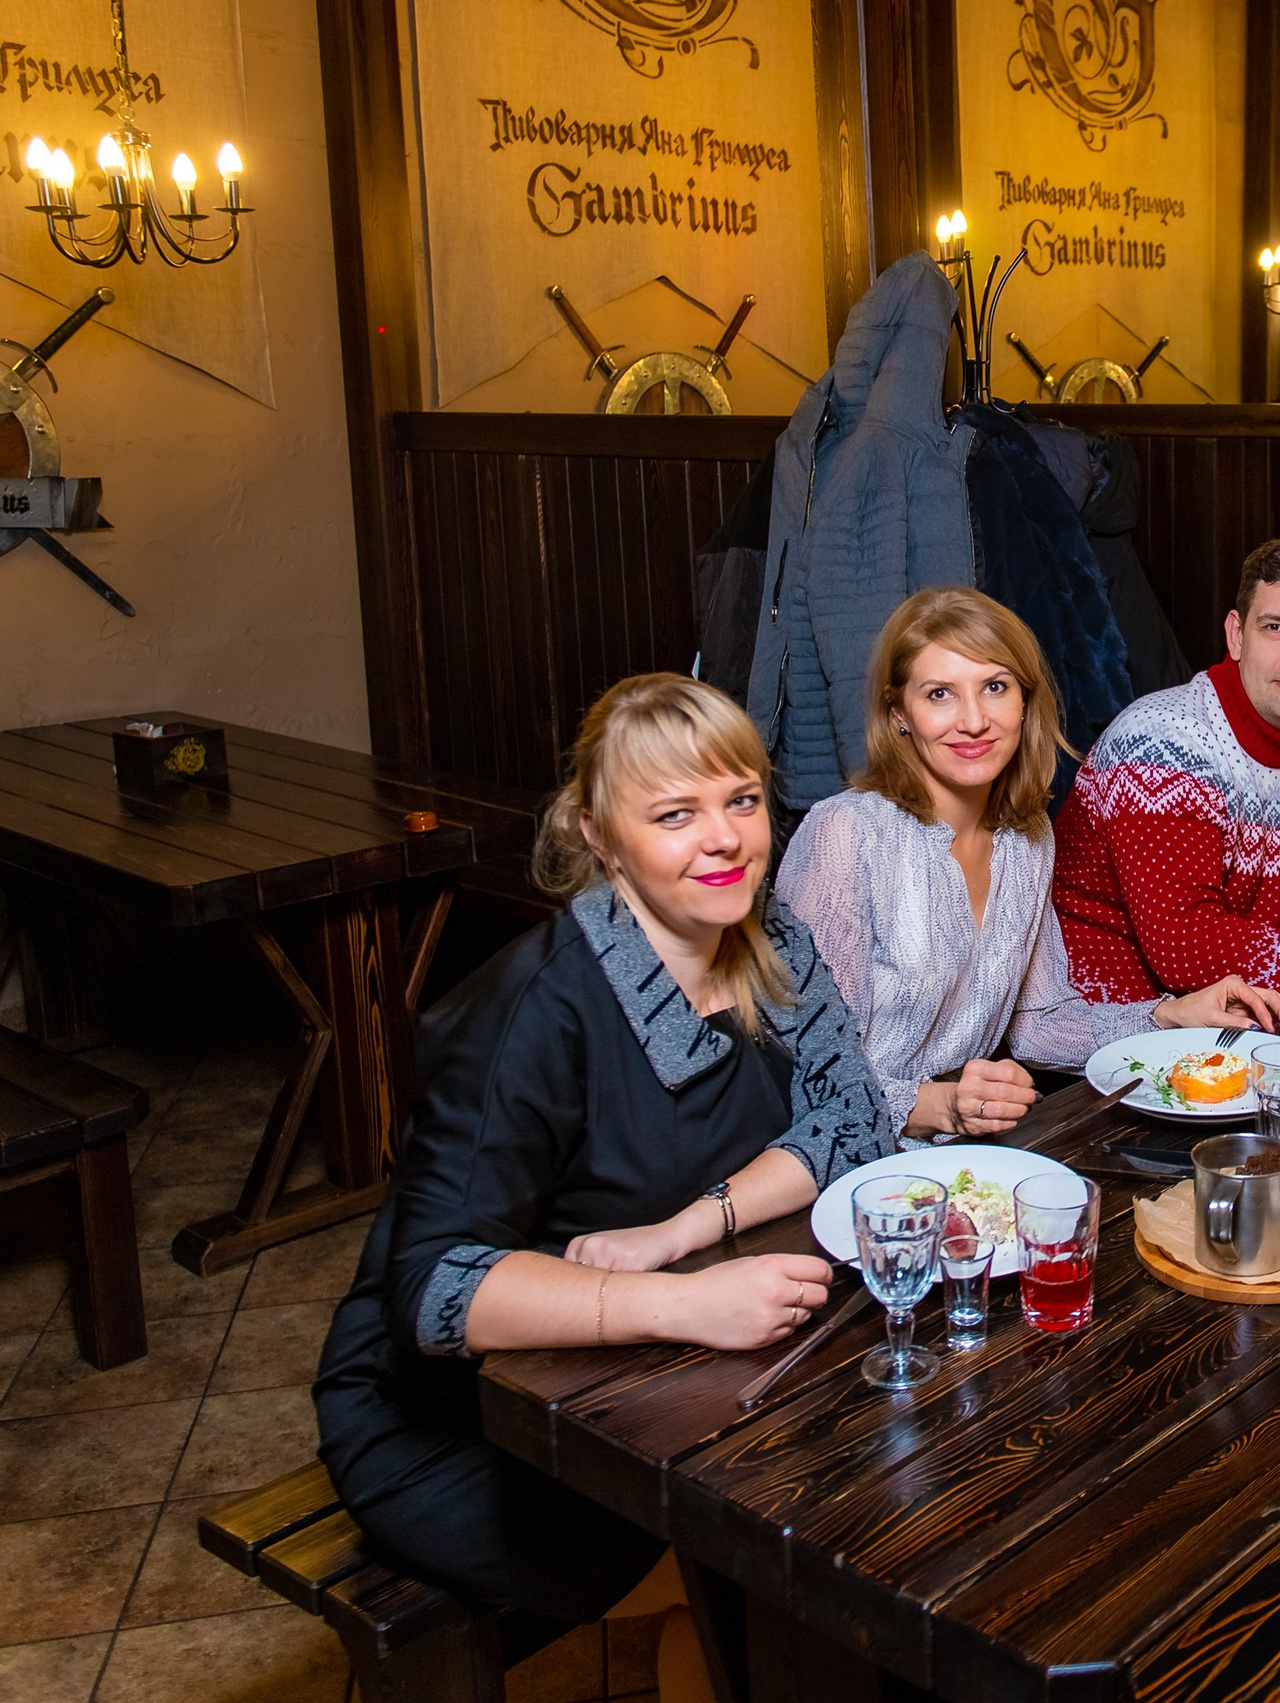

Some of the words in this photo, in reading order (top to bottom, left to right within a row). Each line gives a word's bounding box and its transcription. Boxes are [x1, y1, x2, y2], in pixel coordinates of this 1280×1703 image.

[477, 98, 637, 158] Пивоварня
[637, 114, 688, 157] Яна
[691, 127, 791, 182] Гримуса
[527, 162, 757, 237] Gambrinus
[994, 171, 1086, 214] Пивоварня
[1088, 180, 1121, 212] Яна
[1021, 218, 1166, 276] Gambrinus
